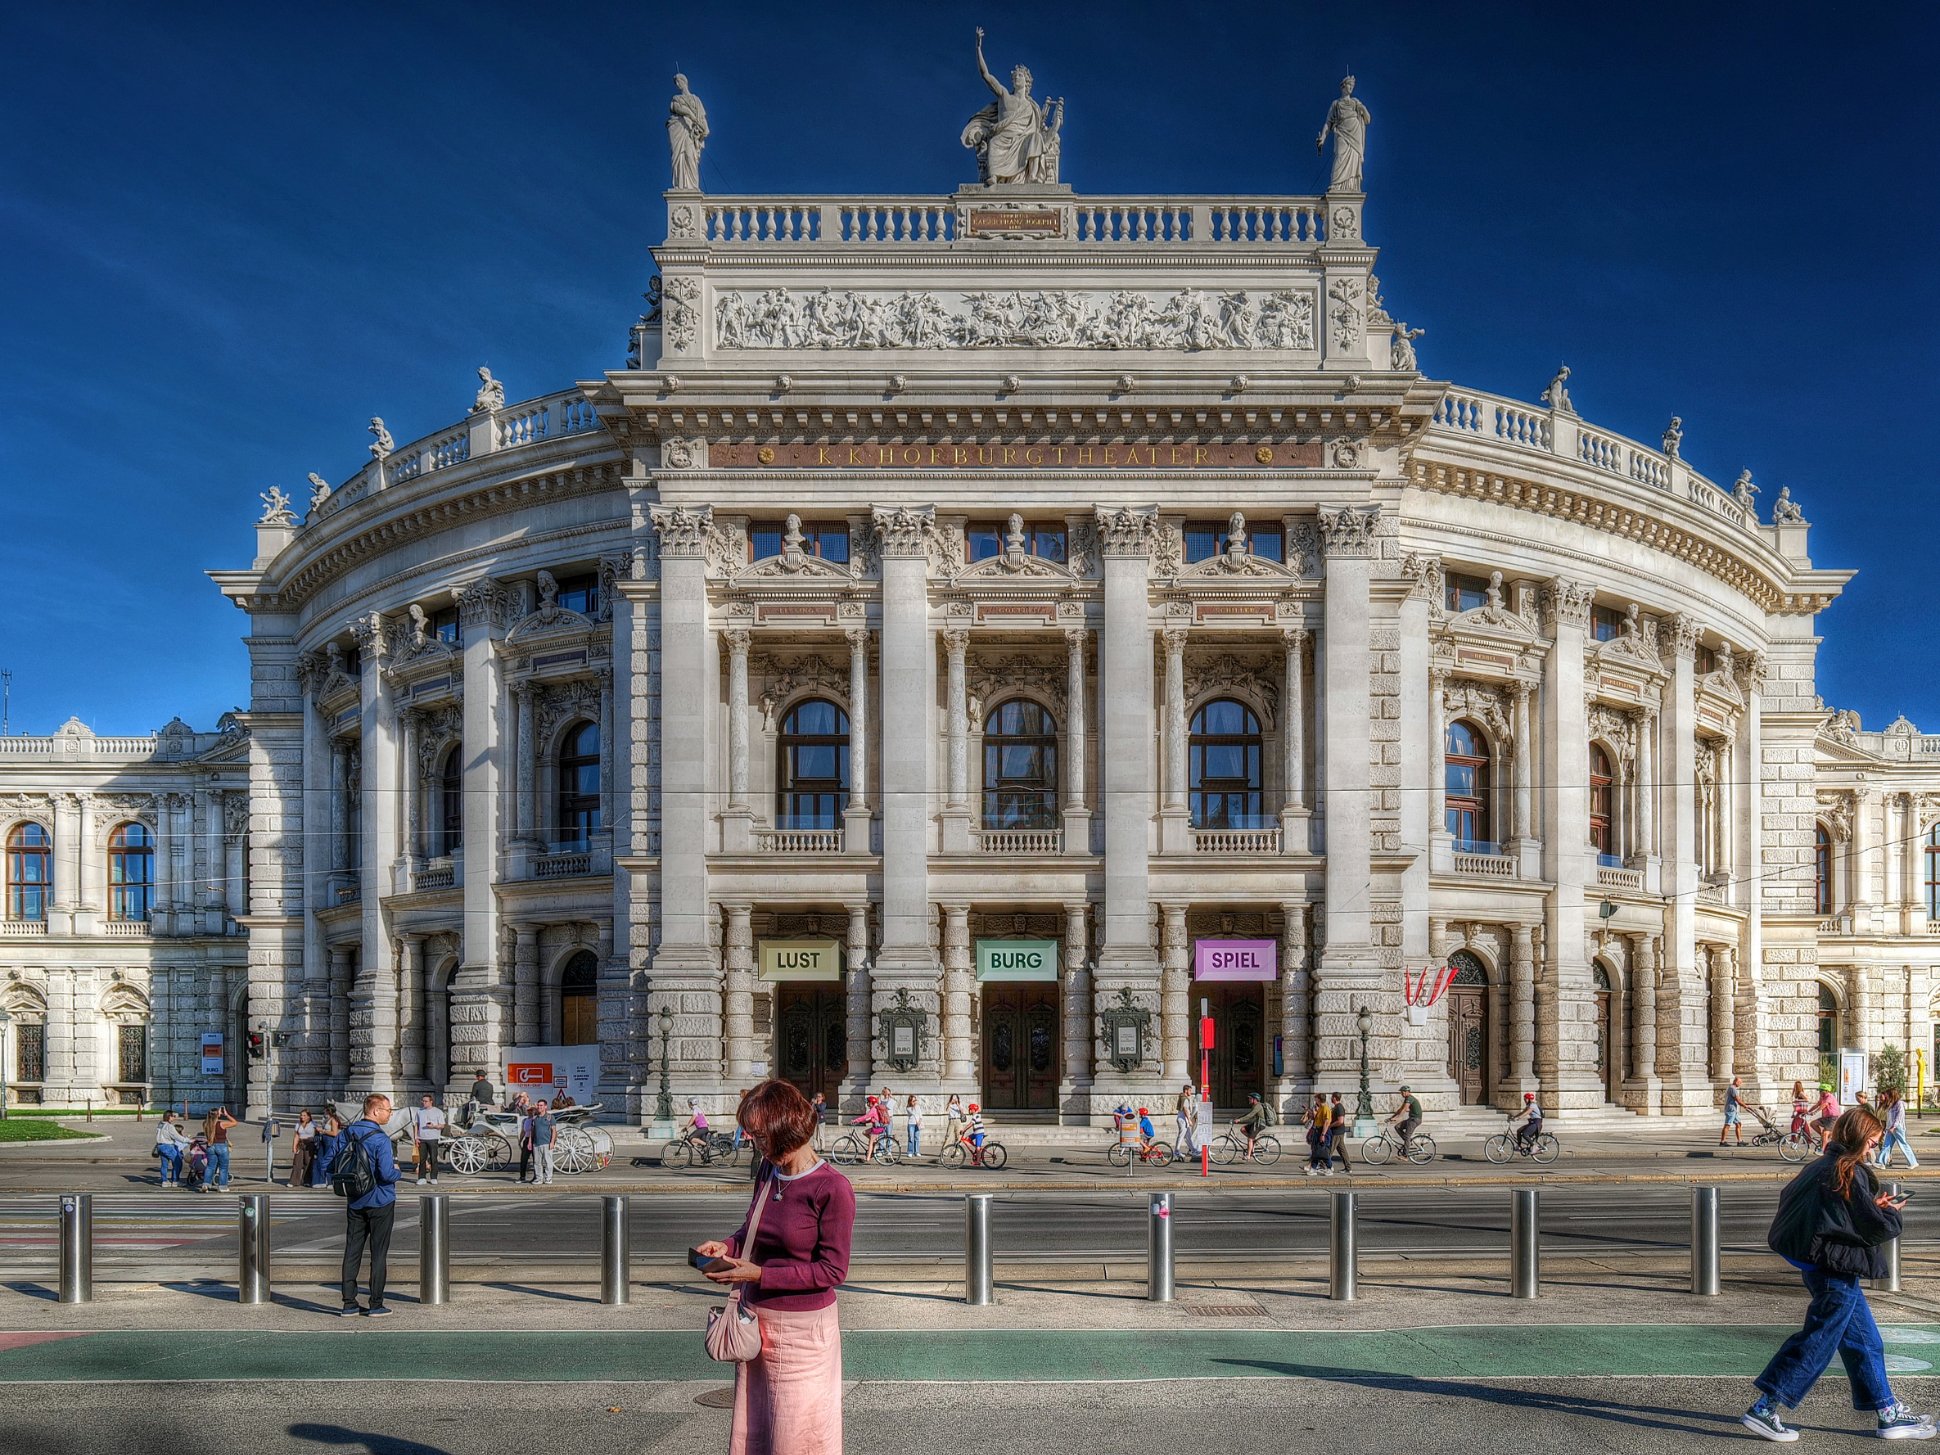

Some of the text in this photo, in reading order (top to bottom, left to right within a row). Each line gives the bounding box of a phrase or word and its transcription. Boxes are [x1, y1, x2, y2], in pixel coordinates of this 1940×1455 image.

[777, 952, 820, 968] LUST
[991, 952, 1042, 968] BURG
[1212, 952, 1260, 968] SPIEL
